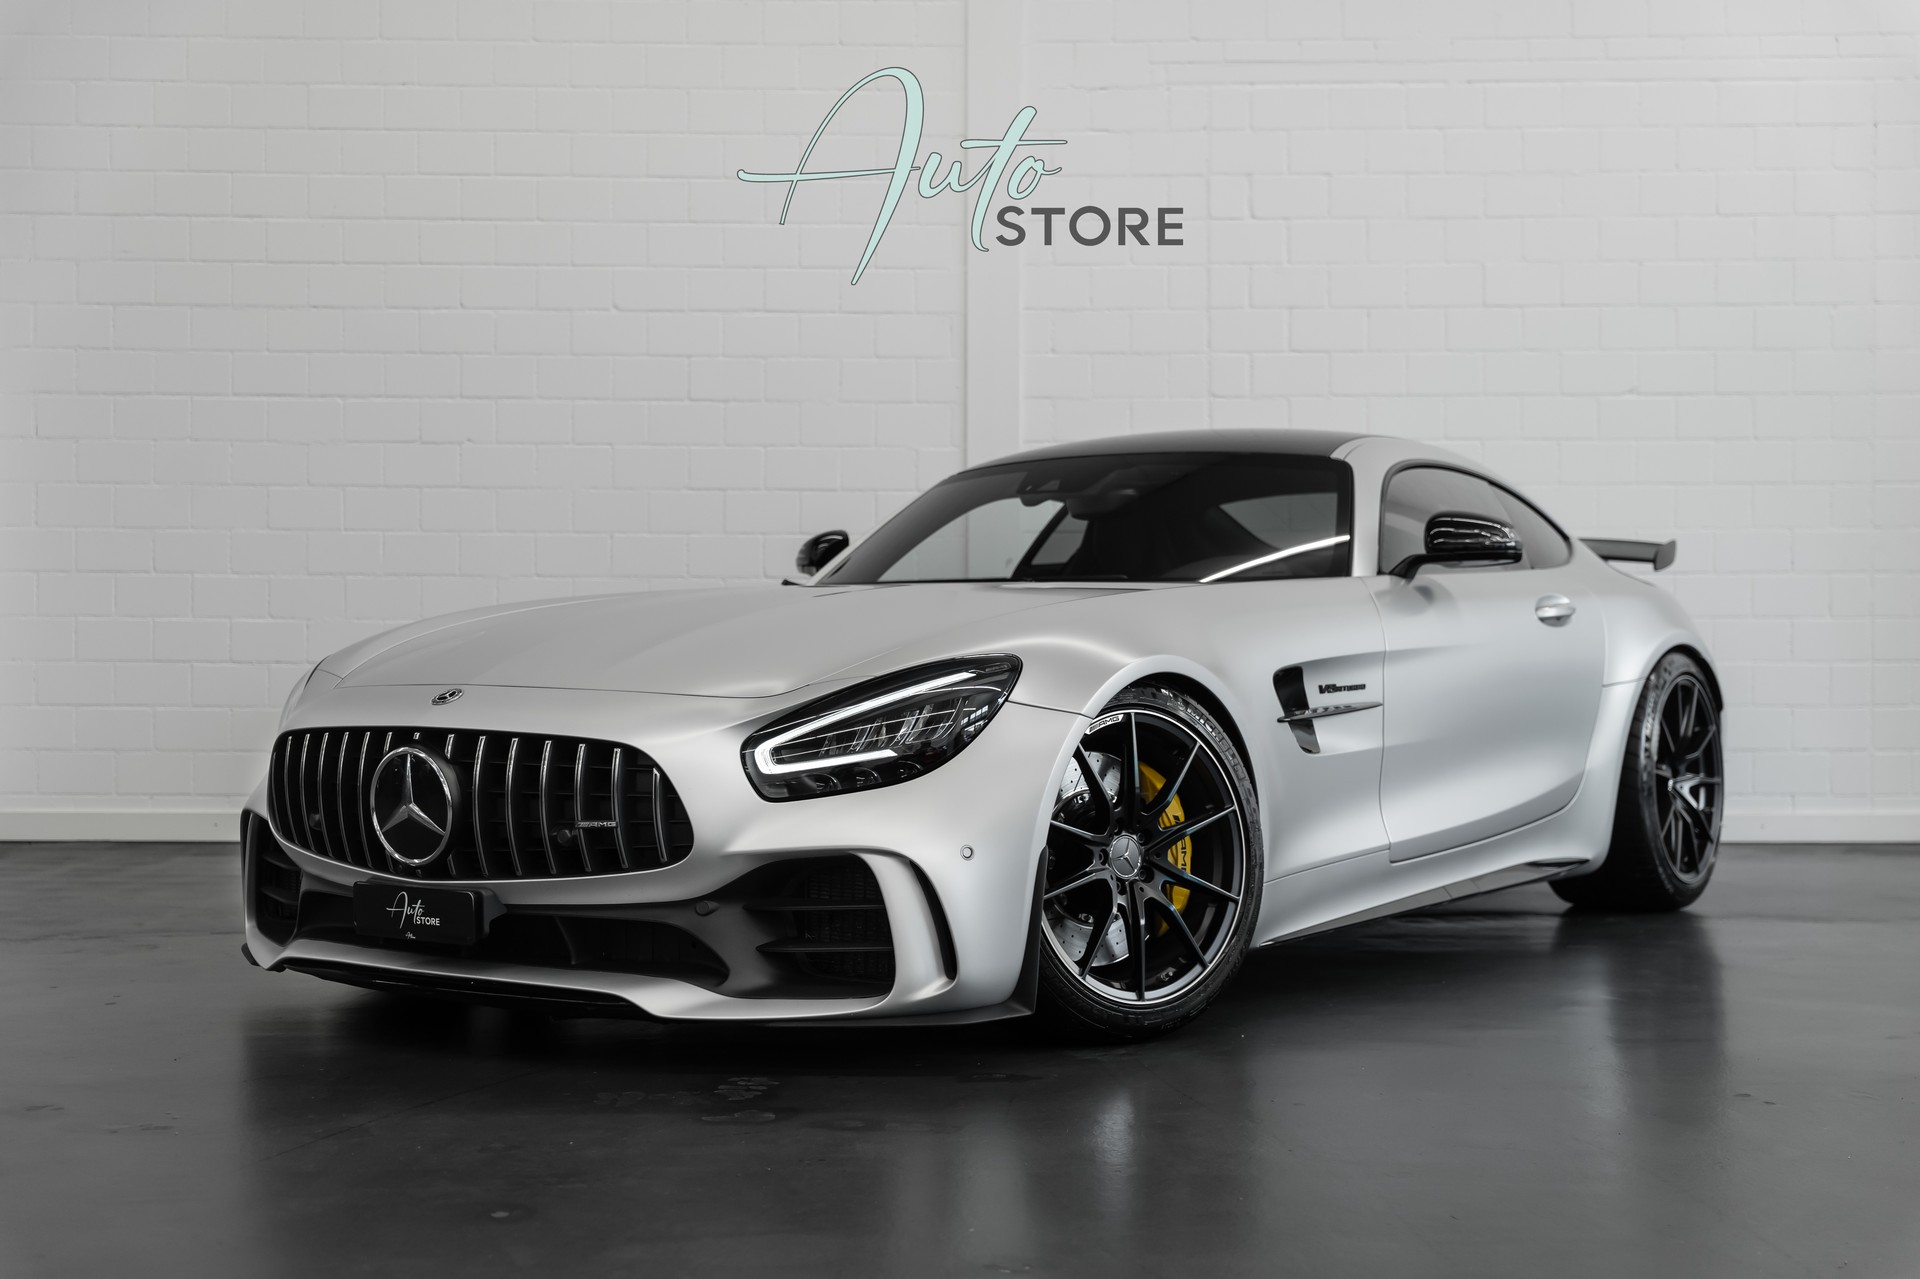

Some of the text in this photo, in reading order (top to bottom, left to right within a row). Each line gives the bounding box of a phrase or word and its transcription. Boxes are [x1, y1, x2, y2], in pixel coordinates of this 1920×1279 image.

[737, 66, 1068, 286] Auto
[995, 205, 1184, 247] STORE
[386, 891, 425, 929] Auto
[416, 916, 440, 926] STORE
